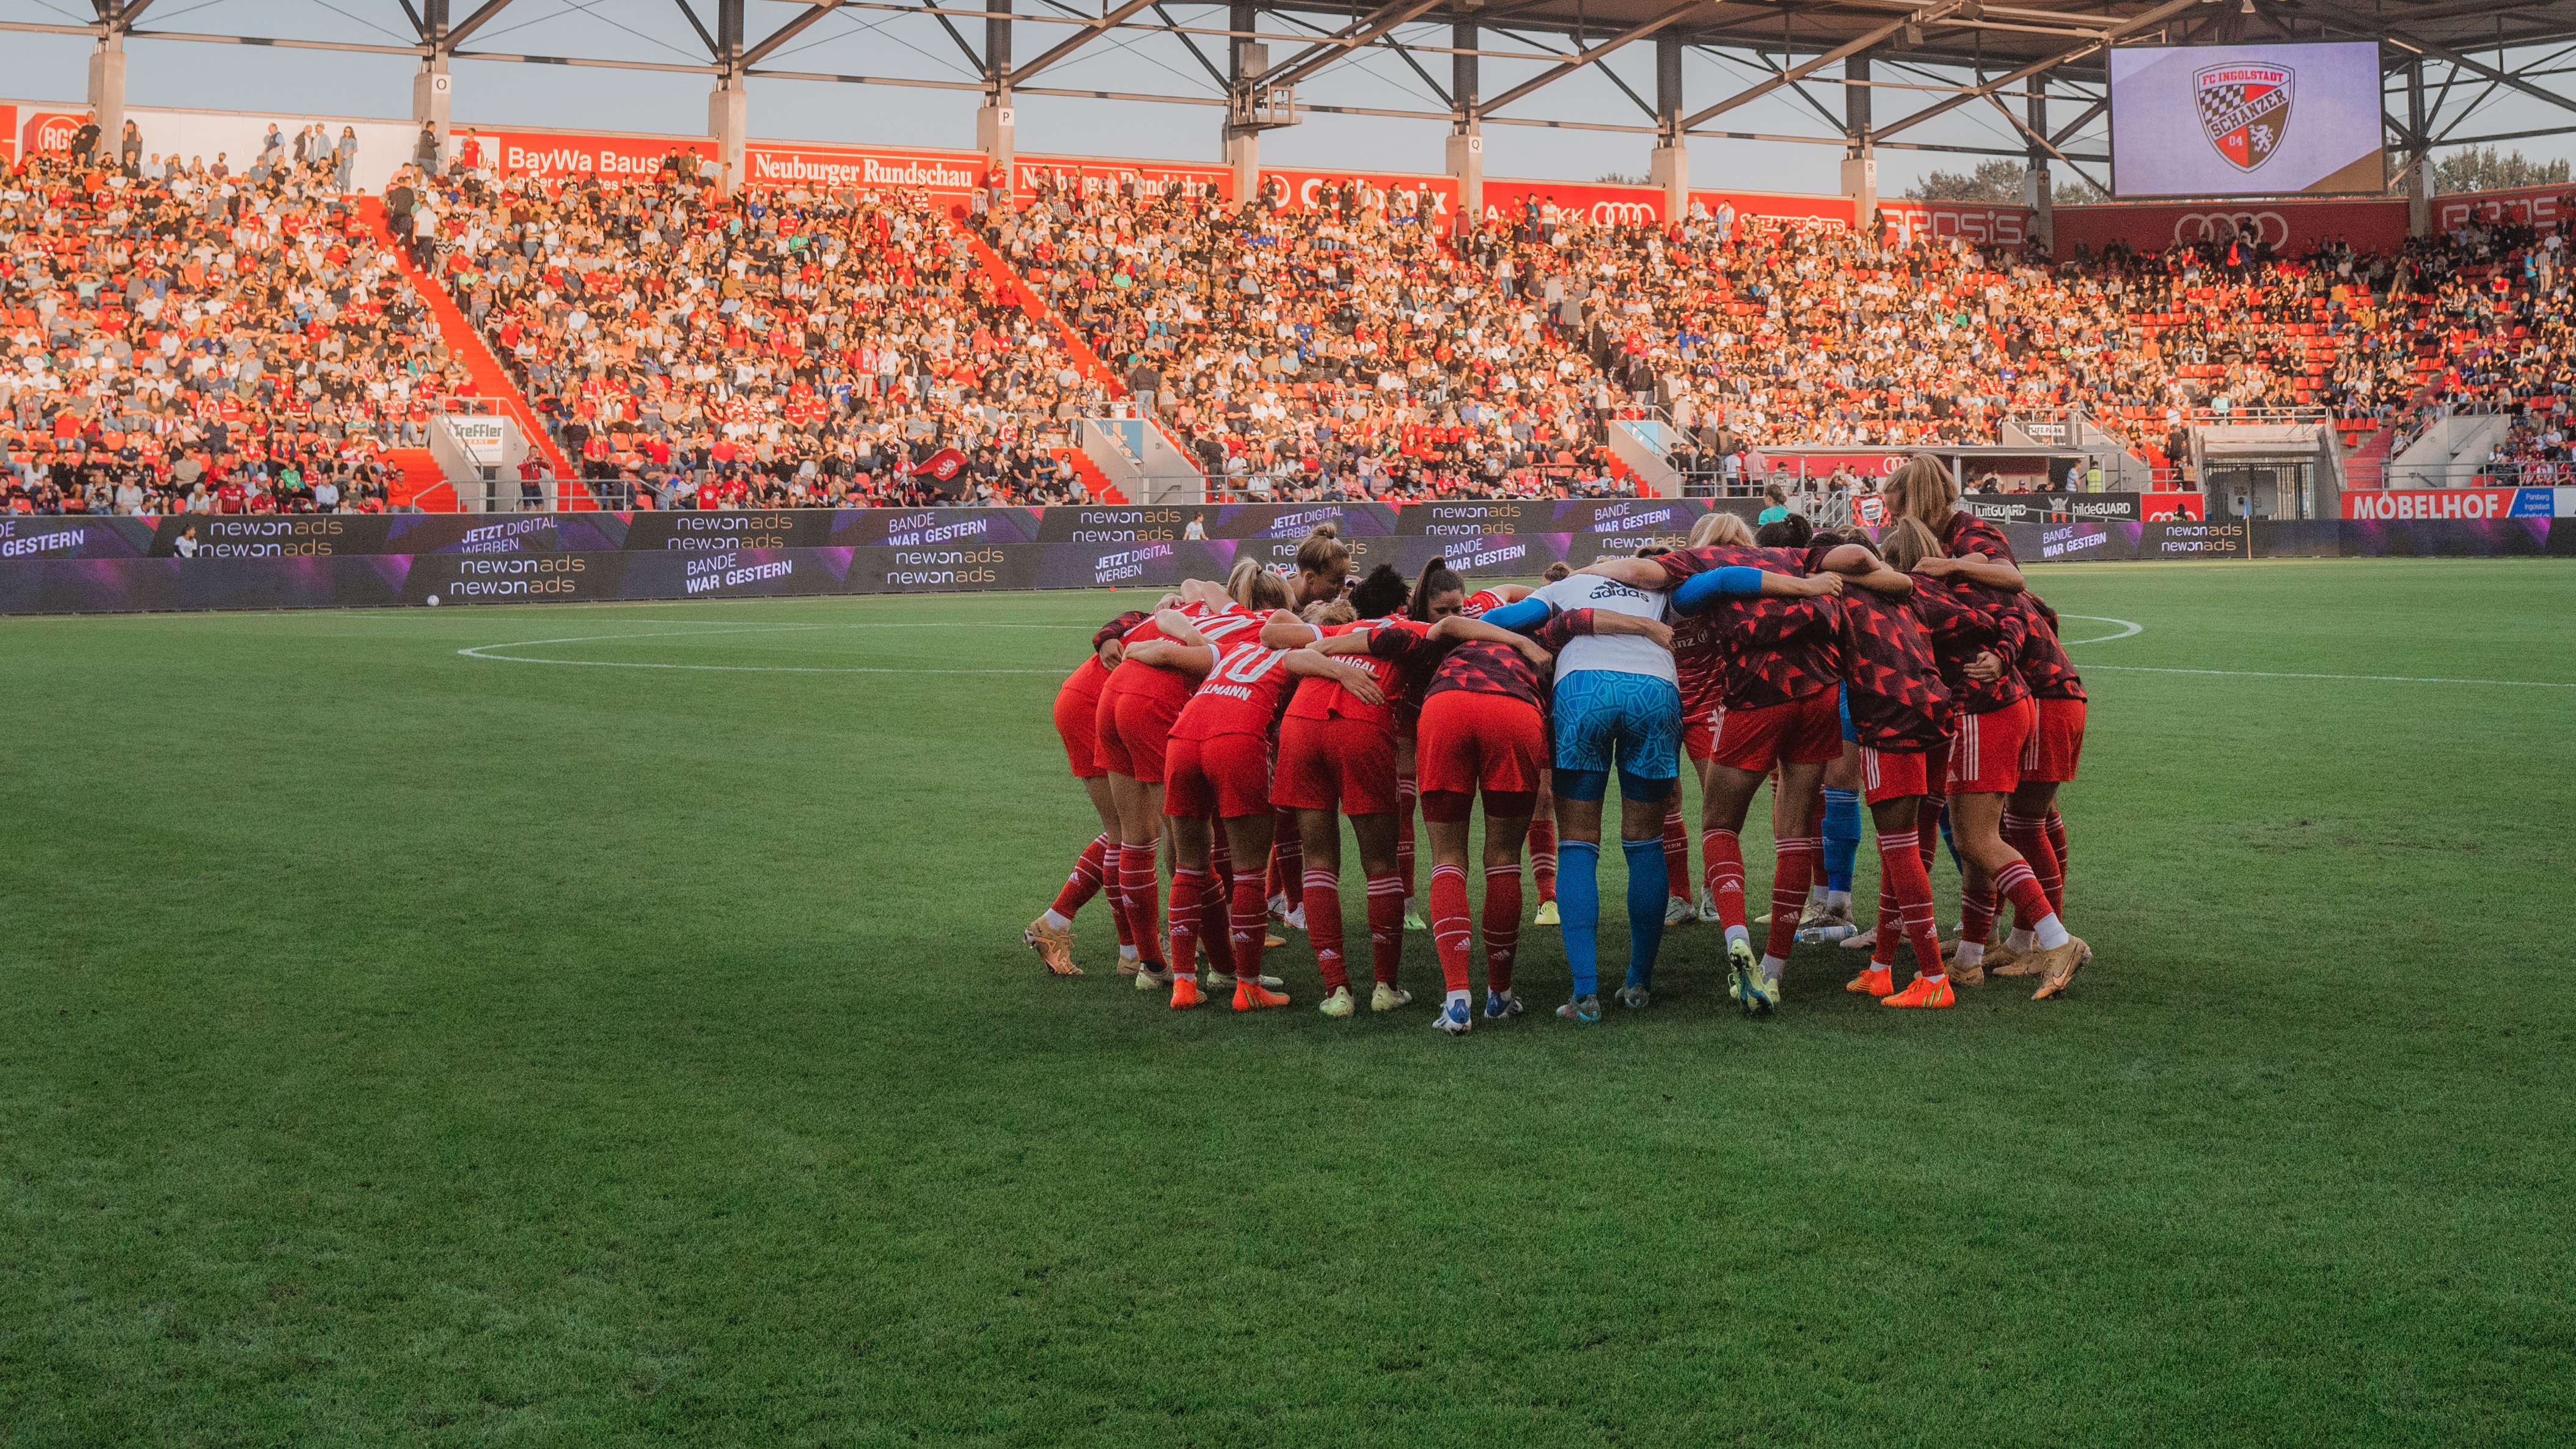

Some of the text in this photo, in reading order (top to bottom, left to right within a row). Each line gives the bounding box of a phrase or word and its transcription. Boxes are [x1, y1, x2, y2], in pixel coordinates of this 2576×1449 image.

[2202, 70, 2284, 86] FC INGOLSTADT
[1003, 112, 1009, 122] P
[2209, 89, 2287, 138] SCHANZER
[1471, 139, 1480, 151] Q
[2228, 135, 2243, 147] 04
[508, 146, 592, 174] BayWa
[755, 153, 973, 188] Neuburger Rundschau
[1867, 163, 1874, 173] R
[1271, 505, 1344, 530] JETZT DIGITAL
[1594, 502, 1630, 521] BANDE
[1594, 508, 1670, 532] WAR GESTERN
[2072, 502, 2131, 515] hildeGUARD
[462, 515, 558, 544] JETZT DIGITAL
[888, 518, 987, 546] WAR GESTERN
[889, 512, 935, 534] BANDE
[2043, 526, 2073, 544] BANDE
[2, 529, 85, 557] GESTERN
[462, 537, 519, 554] WERBEN
[1444, 537, 1484, 558] BANDE
[2043, 532, 2107, 558] WAR GESTERN
[687, 552, 737, 576] BANDE
[1095, 544, 1174, 570] JETZT DIGITAL
[1445, 544, 1526, 571] WAR GESTERN
[686, 559, 792, 594] WAR GESTERN
[1095, 563, 1143, 584] WERBEN
[1589, 587, 1650, 603] adidas
[1206, 641, 1290, 683] 10
